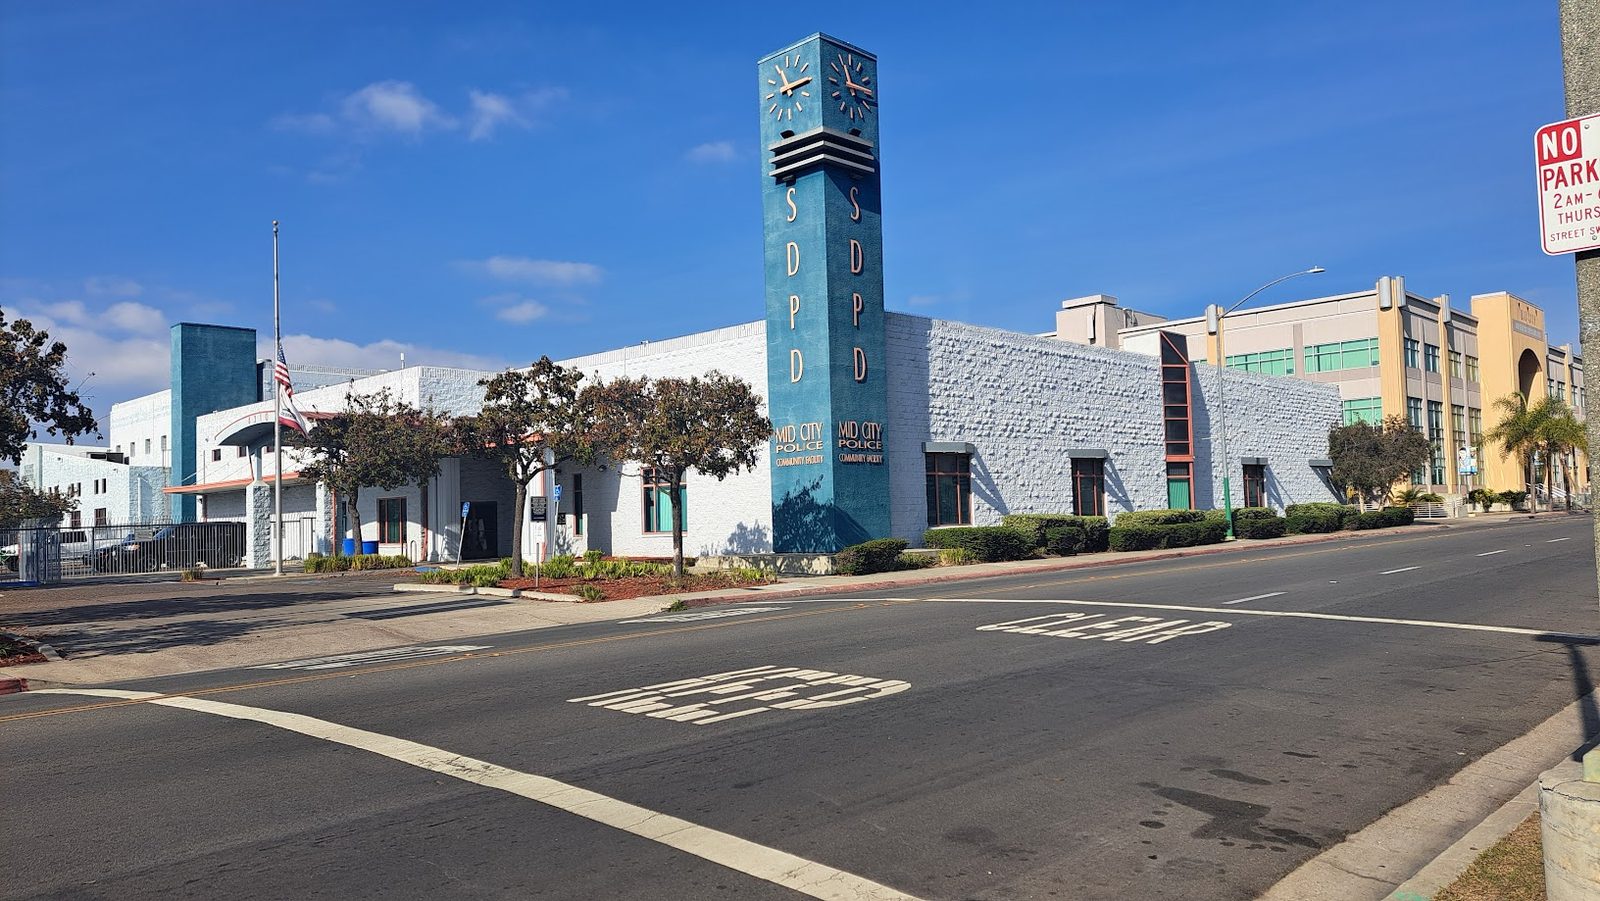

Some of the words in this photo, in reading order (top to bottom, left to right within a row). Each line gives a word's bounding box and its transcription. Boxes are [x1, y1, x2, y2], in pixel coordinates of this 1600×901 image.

[1541, 126, 1578, 161] NO
[1543, 158, 1600, 192] PARK
[1557, 206, 1600, 225] THURS
[1550, 228, 1585, 242] STREET
[775, 425, 796, 443] MID
[800, 422, 823, 441] CITY
[838, 420, 858, 439] MID
[862, 421, 883, 440] CITY
[775, 440, 824, 454] POLICE
[838, 439, 883, 450] POLICE
[975, 612, 1232, 644] CLEAR
[565, 665, 912, 725] KEEP
